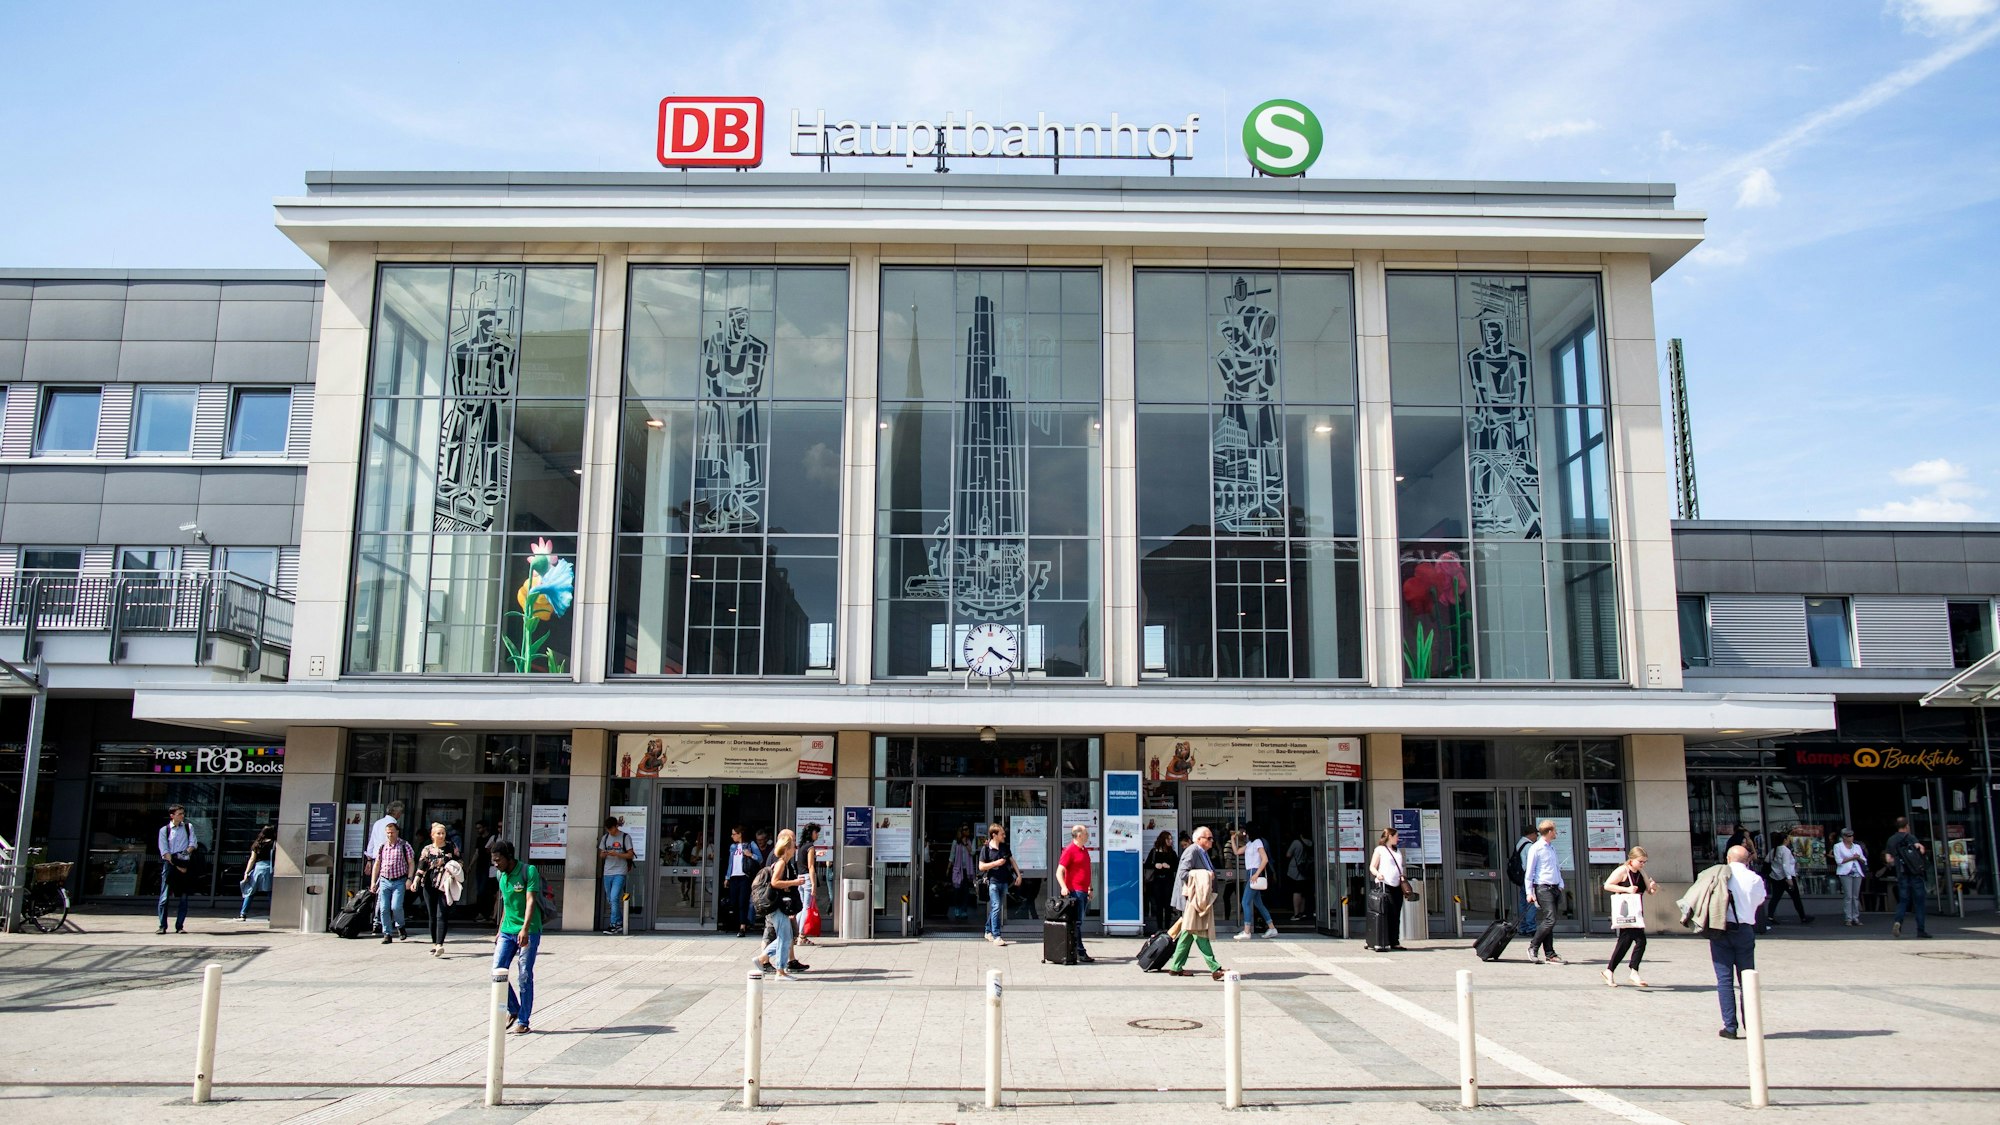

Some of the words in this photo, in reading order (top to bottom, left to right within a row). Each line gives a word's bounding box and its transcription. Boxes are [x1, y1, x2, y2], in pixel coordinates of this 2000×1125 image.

[671, 107, 750, 153] DB
[790, 108, 1199, 167] Hauptbahnhof
[1254, 105, 1310, 169] S
[155, 748, 188, 760] Press
[196, 747, 243, 773] P&B
[246, 761, 284, 773] Books
[1796, 750, 1850, 767] Kamps
[1880, 747, 1963, 771] Backstube
